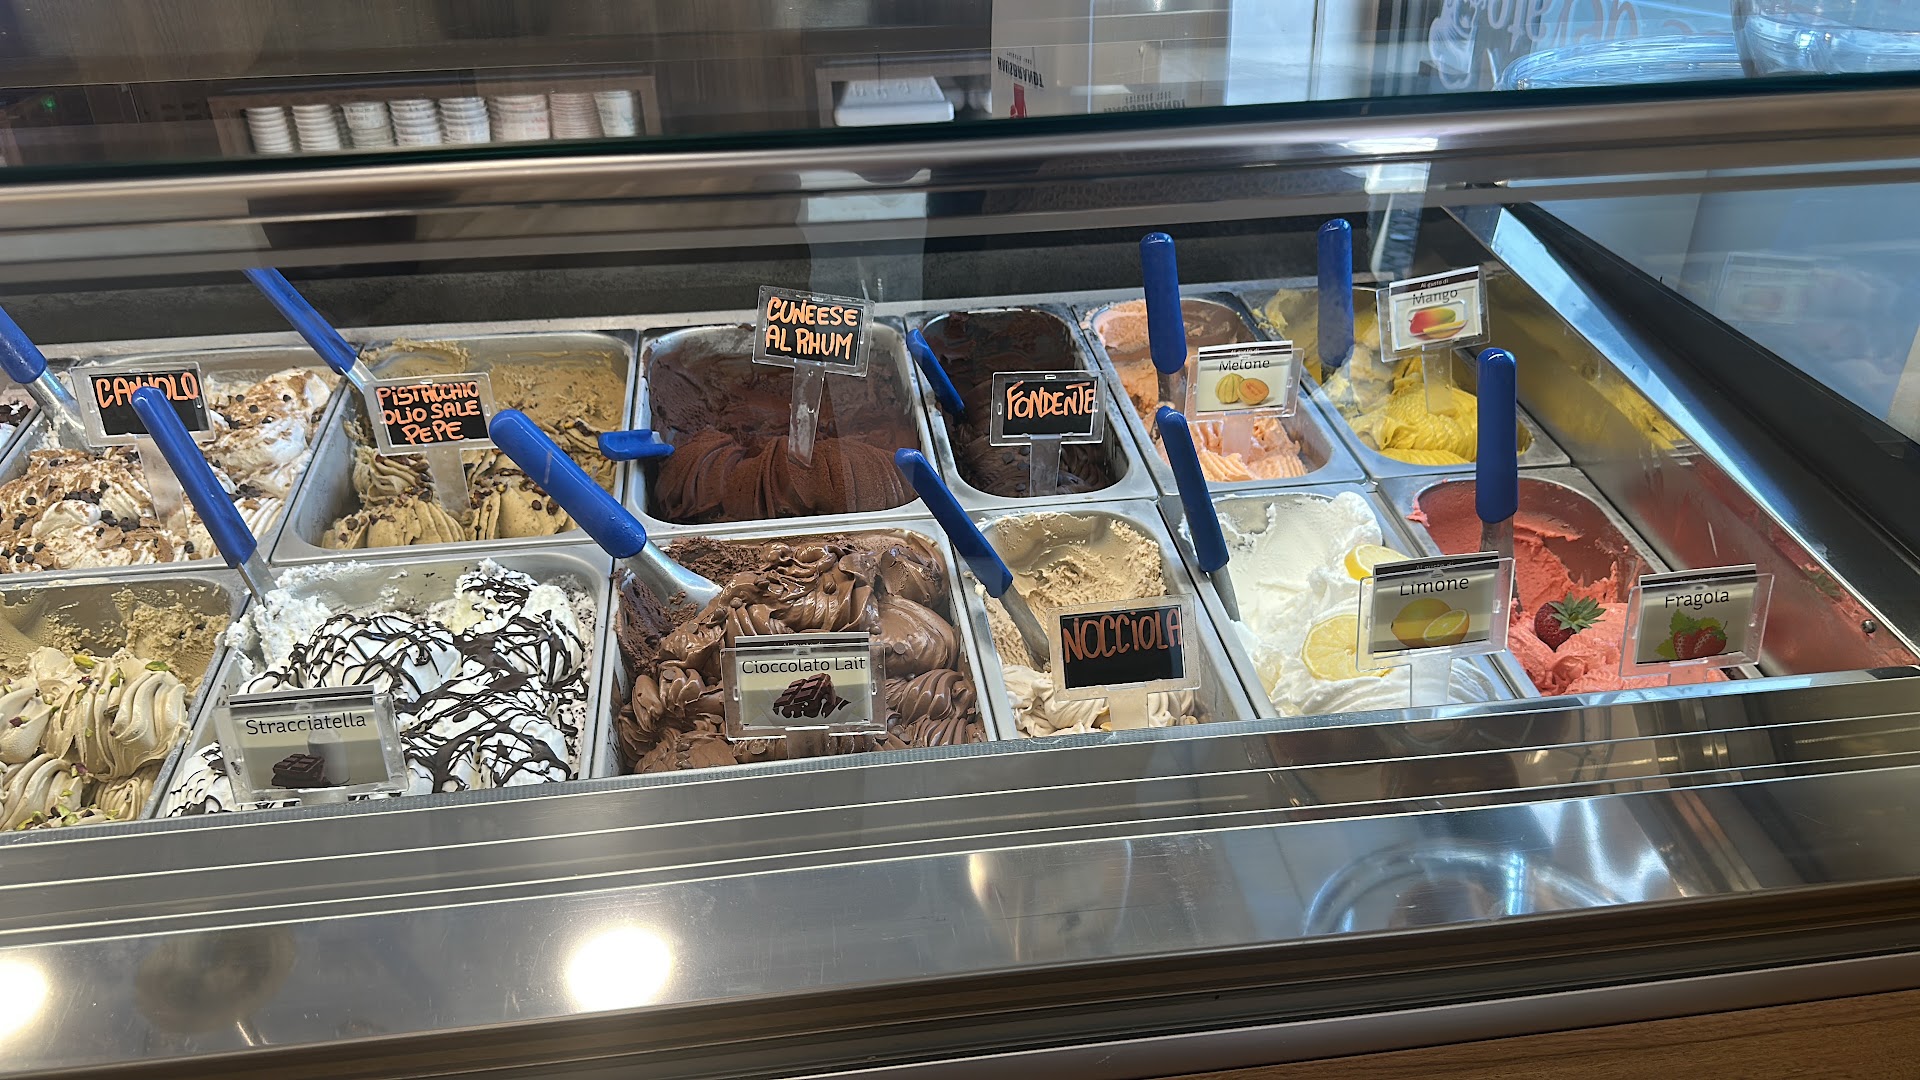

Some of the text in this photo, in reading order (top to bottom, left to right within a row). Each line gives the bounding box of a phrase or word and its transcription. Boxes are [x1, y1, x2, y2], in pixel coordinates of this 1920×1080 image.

[1412, 289, 1458, 305] Mango
[766, 296, 858, 327] CUNEESE
[765, 324, 853, 360] AL RHUM
[1218, 358, 1270, 372] Melone
[430, 400, 481, 420] SALE
[1006, 380, 1094, 421] FONDENTE
[402, 420, 464, 445] PEPE
[1400, 577, 1469, 596] Limone
[1665, 590, 1729, 610] Fragola
[742, 656, 866, 674] Cioccolato Lait
[245, 712, 367, 735] Stracciatella
